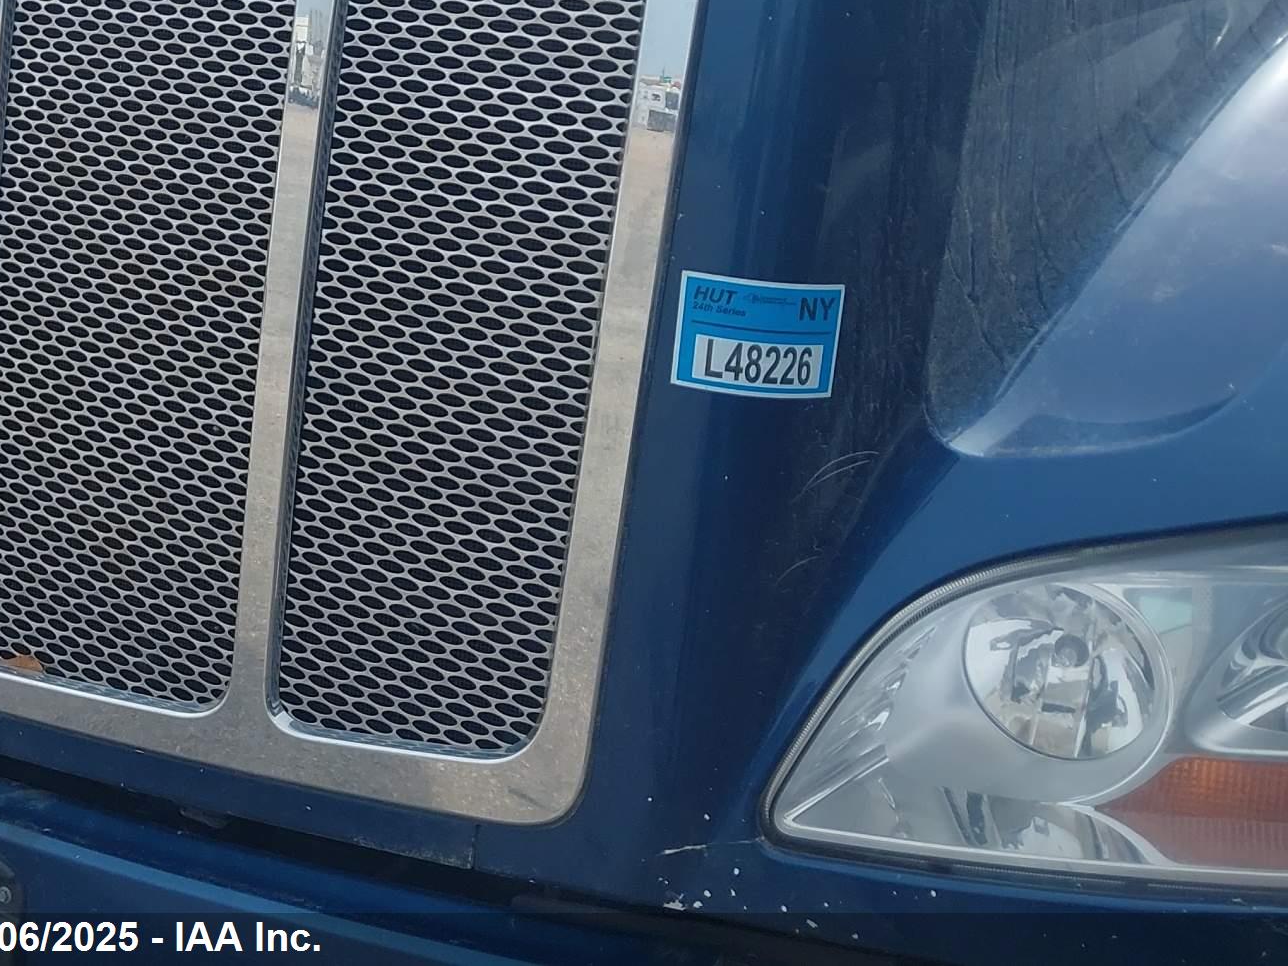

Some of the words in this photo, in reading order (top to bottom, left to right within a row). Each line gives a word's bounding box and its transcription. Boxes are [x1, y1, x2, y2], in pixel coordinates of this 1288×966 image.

[692, 285, 738, 305] HUT
[693, 301, 714, 312] 24th
[716, 305, 747, 317] Series
[798, 297, 835, 322] NY
[704, 338, 813, 386] L48226
